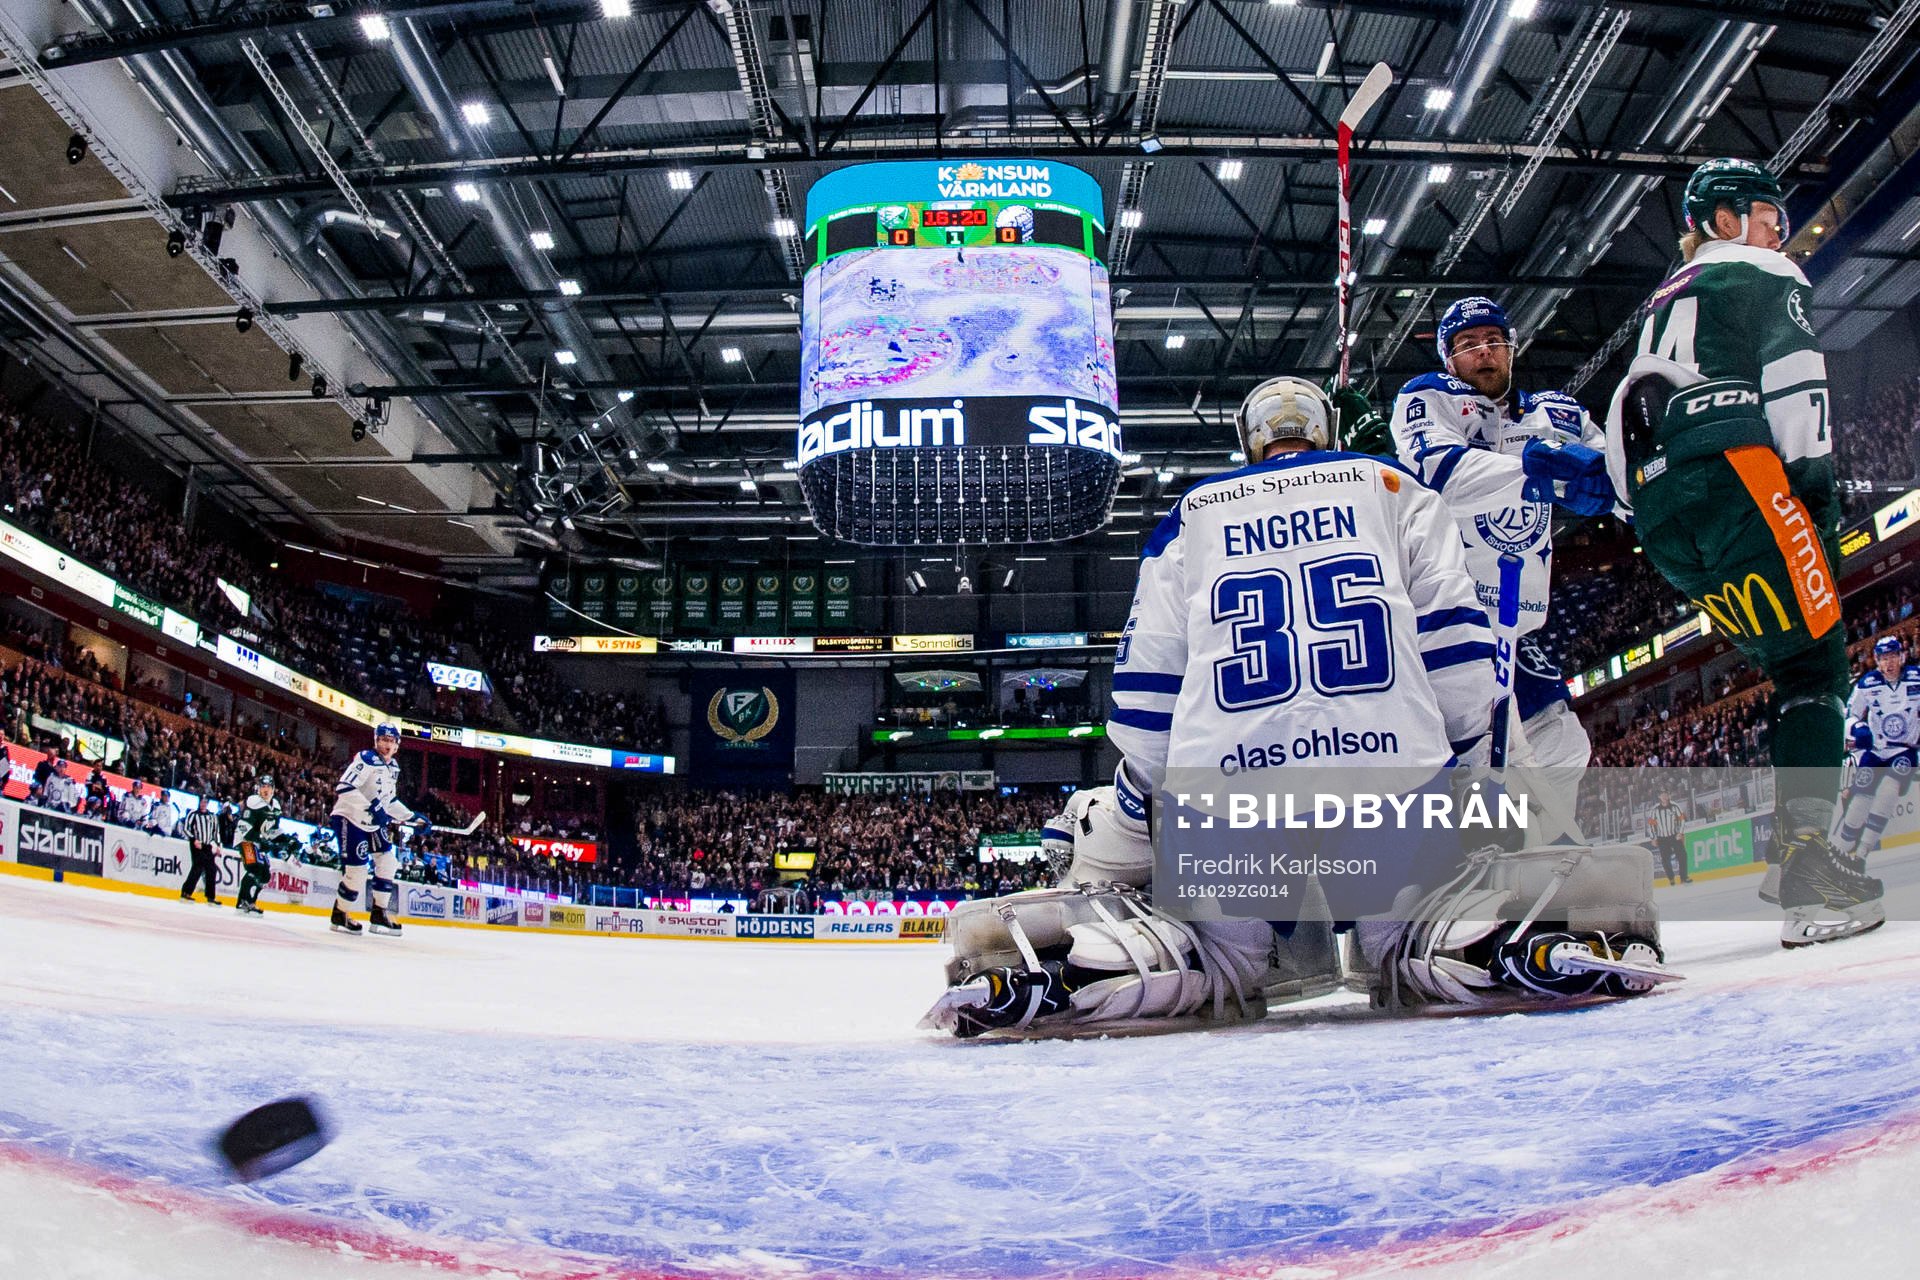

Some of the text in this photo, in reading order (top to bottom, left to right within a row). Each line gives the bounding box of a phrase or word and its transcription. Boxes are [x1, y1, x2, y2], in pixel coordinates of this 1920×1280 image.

[937, 181, 1053, 199] VÄRMLAND
[895, 229, 907, 244] 0
[950, 232, 960, 245] 1
[1002, 228, 1014, 243] 0
[1462, 308, 1490, 319] ohlson
[1408, 406, 1422, 419] NS
[1683, 389, 1759, 416] CCM
[1262, 465, 1366, 498] Sparbank
[1223, 505, 1358, 558] ENGREN
[1484, 534, 1533, 554] ISHOCKEY
[910, 634, 974, 651] Sonnelids
[1211, 551, 1396, 714] 35
[596, 639, 643, 650] Vi SYNS
[1219, 725, 1400, 779] clas ohlson
[19, 820, 103, 865] stadium
[1692, 827, 1744, 869] print
[452, 894, 481, 918] ELON
[736, 915, 815, 938] HÖJDENS
[830, 922, 895, 934] REJLERS
